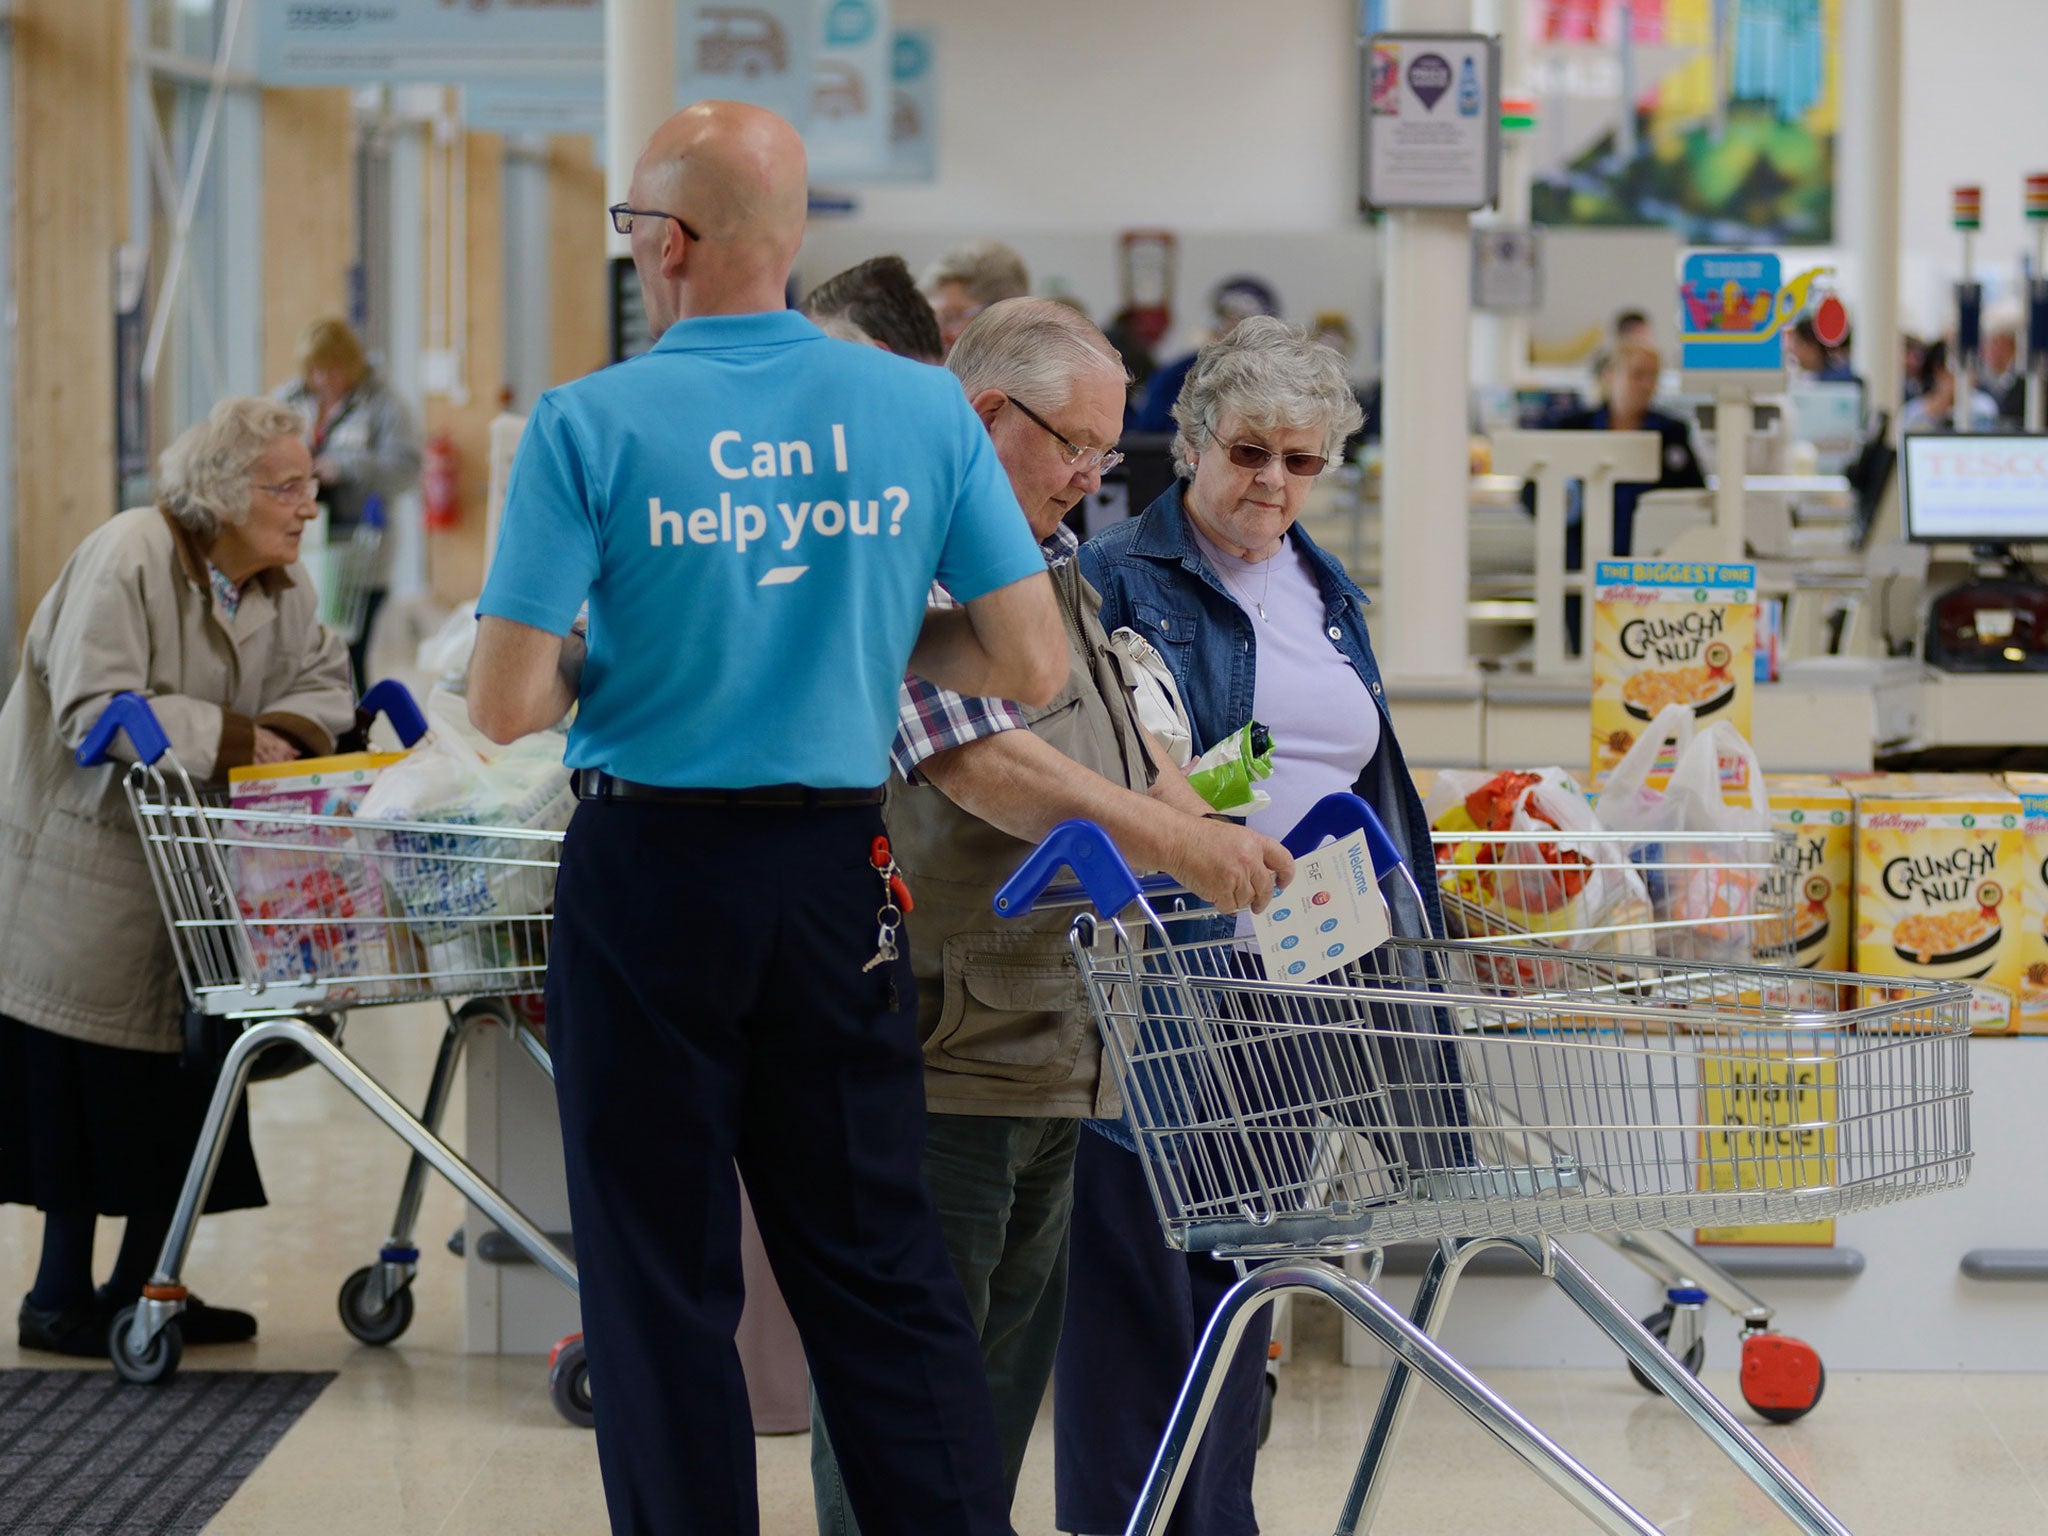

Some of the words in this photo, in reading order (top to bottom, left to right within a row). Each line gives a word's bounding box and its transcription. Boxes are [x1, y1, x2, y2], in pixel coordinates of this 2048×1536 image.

[709, 430, 814, 480] Can
[831, 423, 849, 473] I
[648, 492, 767, 553] help
[777, 486, 910, 551] you?
[1602, 565, 1629, 579] THE
[1633, 564, 1717, 583] BIGGEST
[1720, 568, 1750, 582] ONE
[1620, 607, 1725, 660] CRUNCHY
[1655, 638, 1704, 666] NUT
[1306, 862, 1323, 880] F&F
[1347, 842, 1368, 896] Welcome
[1882, 841, 1997, 901] CRUNCHY
[1922, 876, 1975, 907] NUT
[1734, 1072, 1812, 1102] Half
